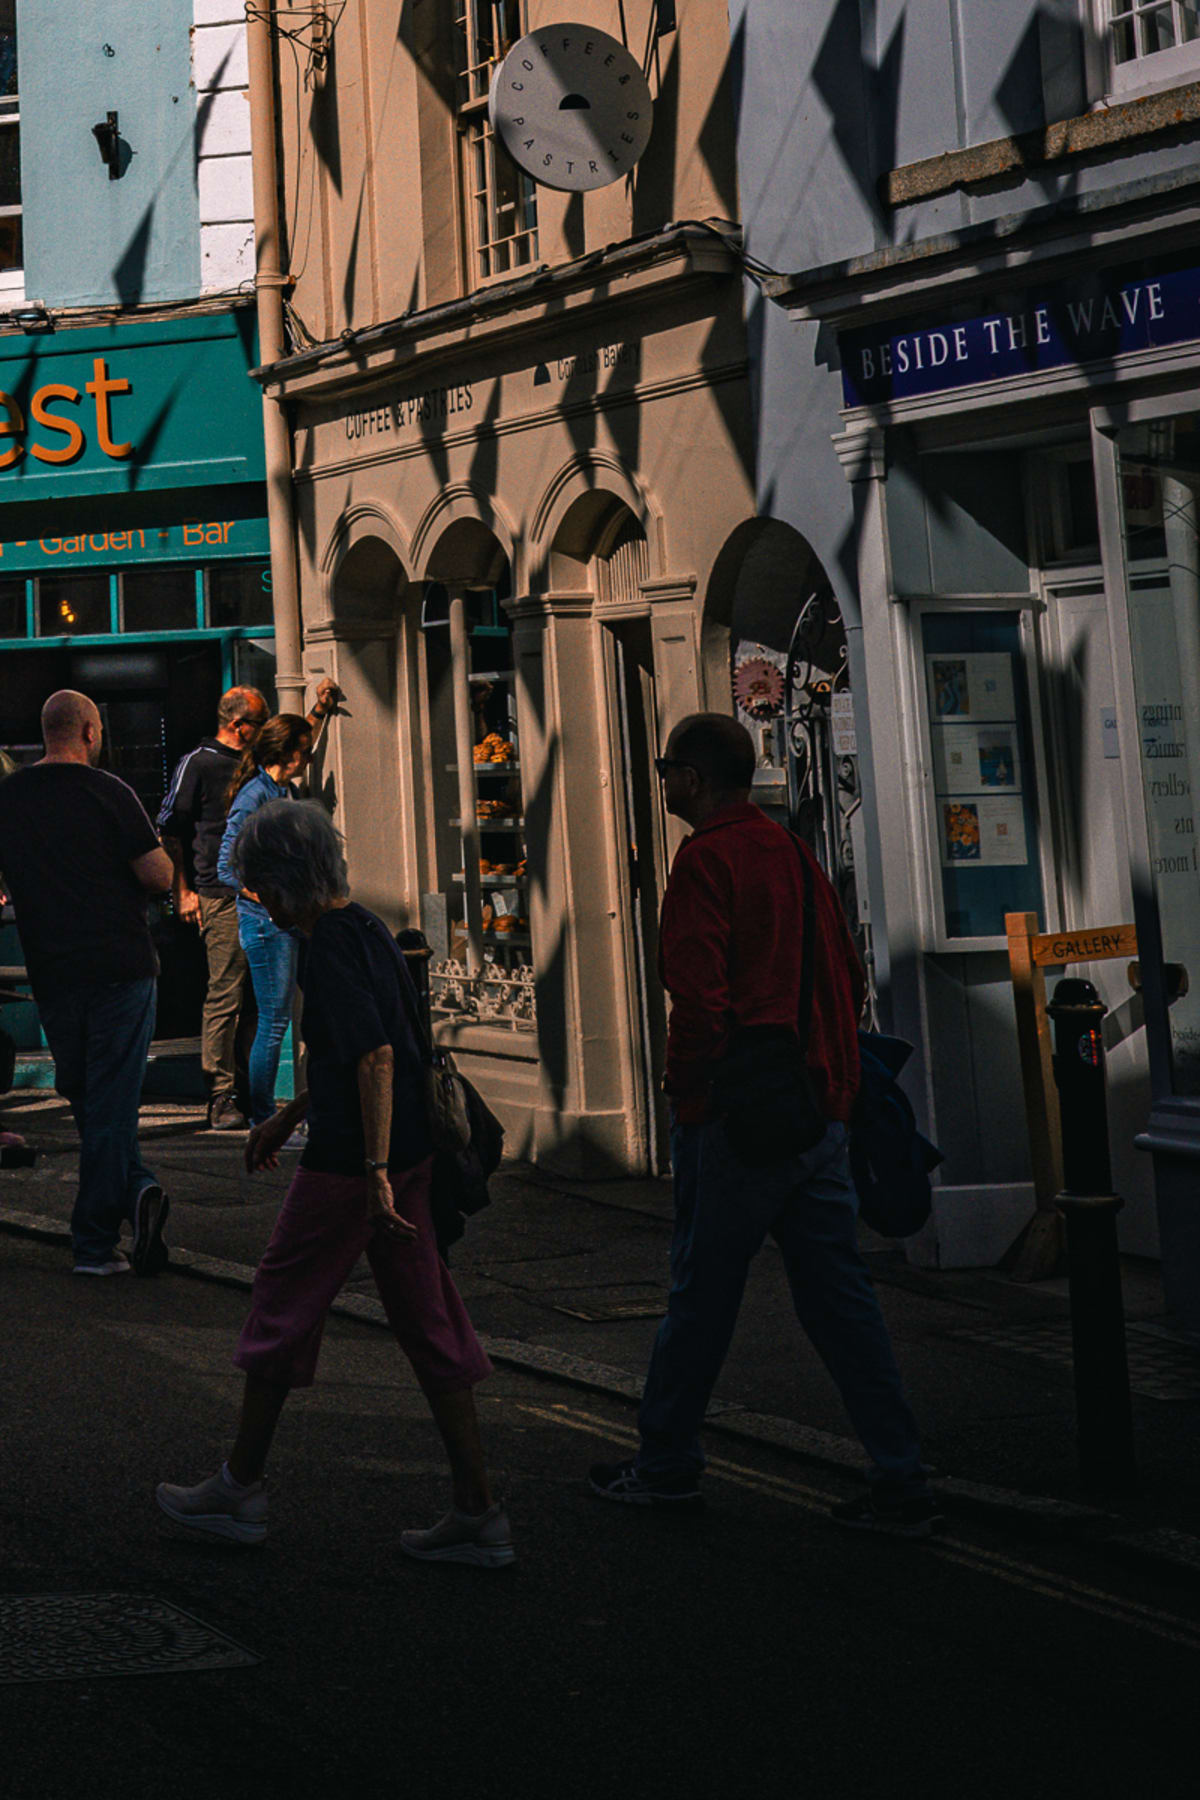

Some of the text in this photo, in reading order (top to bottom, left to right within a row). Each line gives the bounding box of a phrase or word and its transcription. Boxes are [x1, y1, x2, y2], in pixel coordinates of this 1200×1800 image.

[511, 38, 631, 91] COFFEE &
[513, 111, 639, 174] PASTRIES
[861, 283, 1165, 380] BESIDE THE WAVE
[346, 403, 390, 439] COFFEE
[408, 380, 472, 425] PASTRIES
[39, 521, 145, 555] Garden
[183, 518, 235, 547] Bar
[1053, 934, 1120, 958] GALLERY
